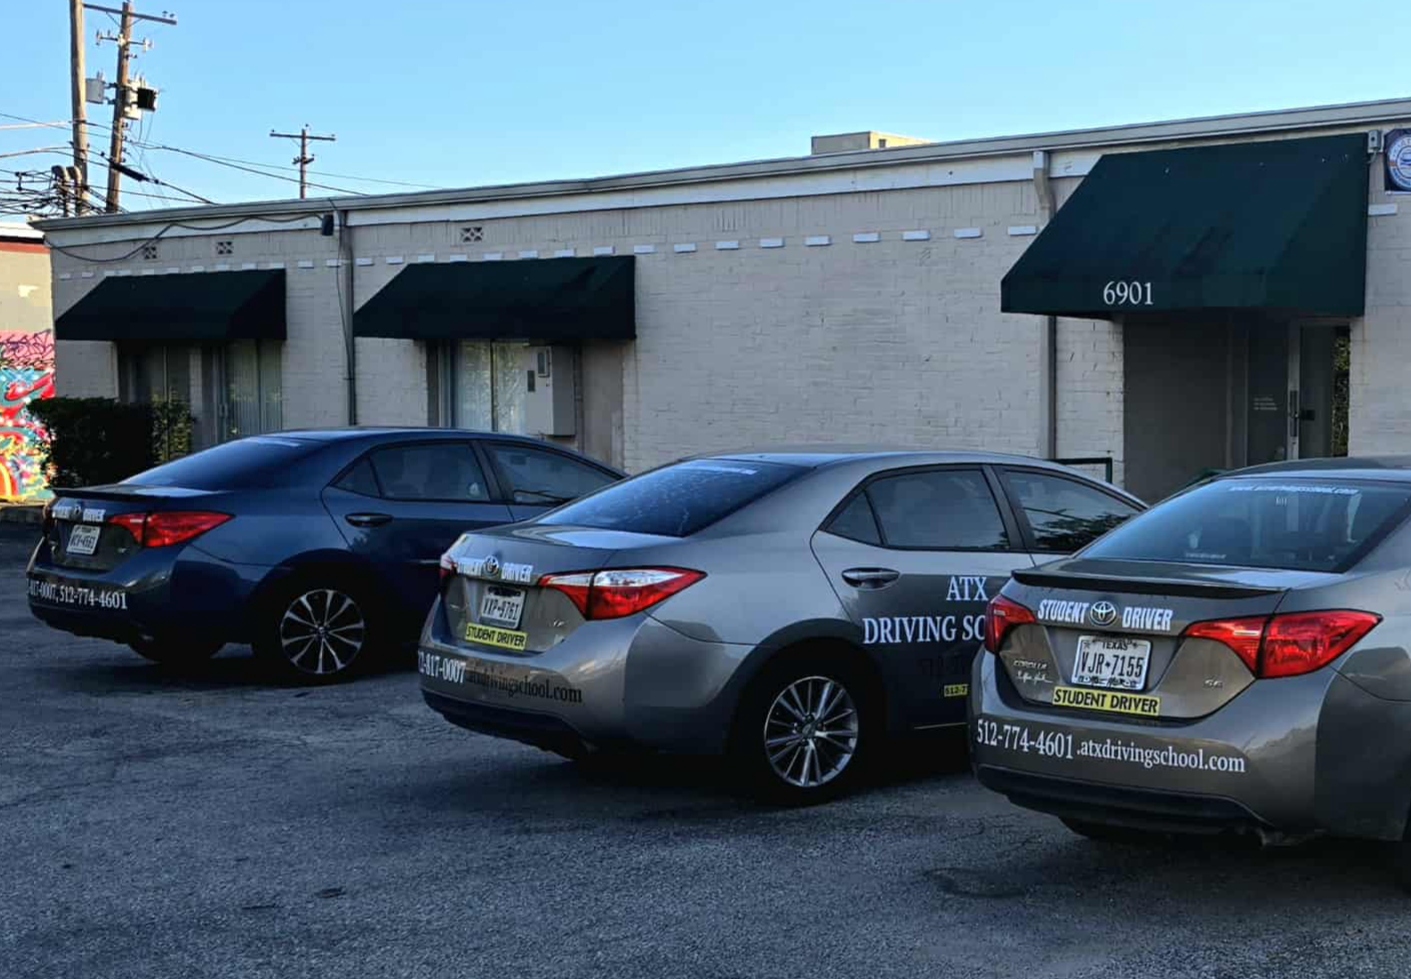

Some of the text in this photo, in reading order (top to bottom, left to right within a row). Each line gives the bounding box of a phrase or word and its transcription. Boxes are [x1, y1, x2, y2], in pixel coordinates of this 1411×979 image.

[1103, 281, 1153, 305] 6901
[59, 585, 128, 609] 512-774-4601
[946, 576, 988, 601] ATX
[1037, 599, 1173, 631] STUDENT DRIVER
[467, 625, 525, 647] STUDENT DRIVER
[862, 616, 957, 644] DRIVING
[1102, 640, 1128, 651] TEXAS
[1054, 689, 1158, 713] STUDENT DRIVER
[977, 719, 1073, 759] 512-774-4601
